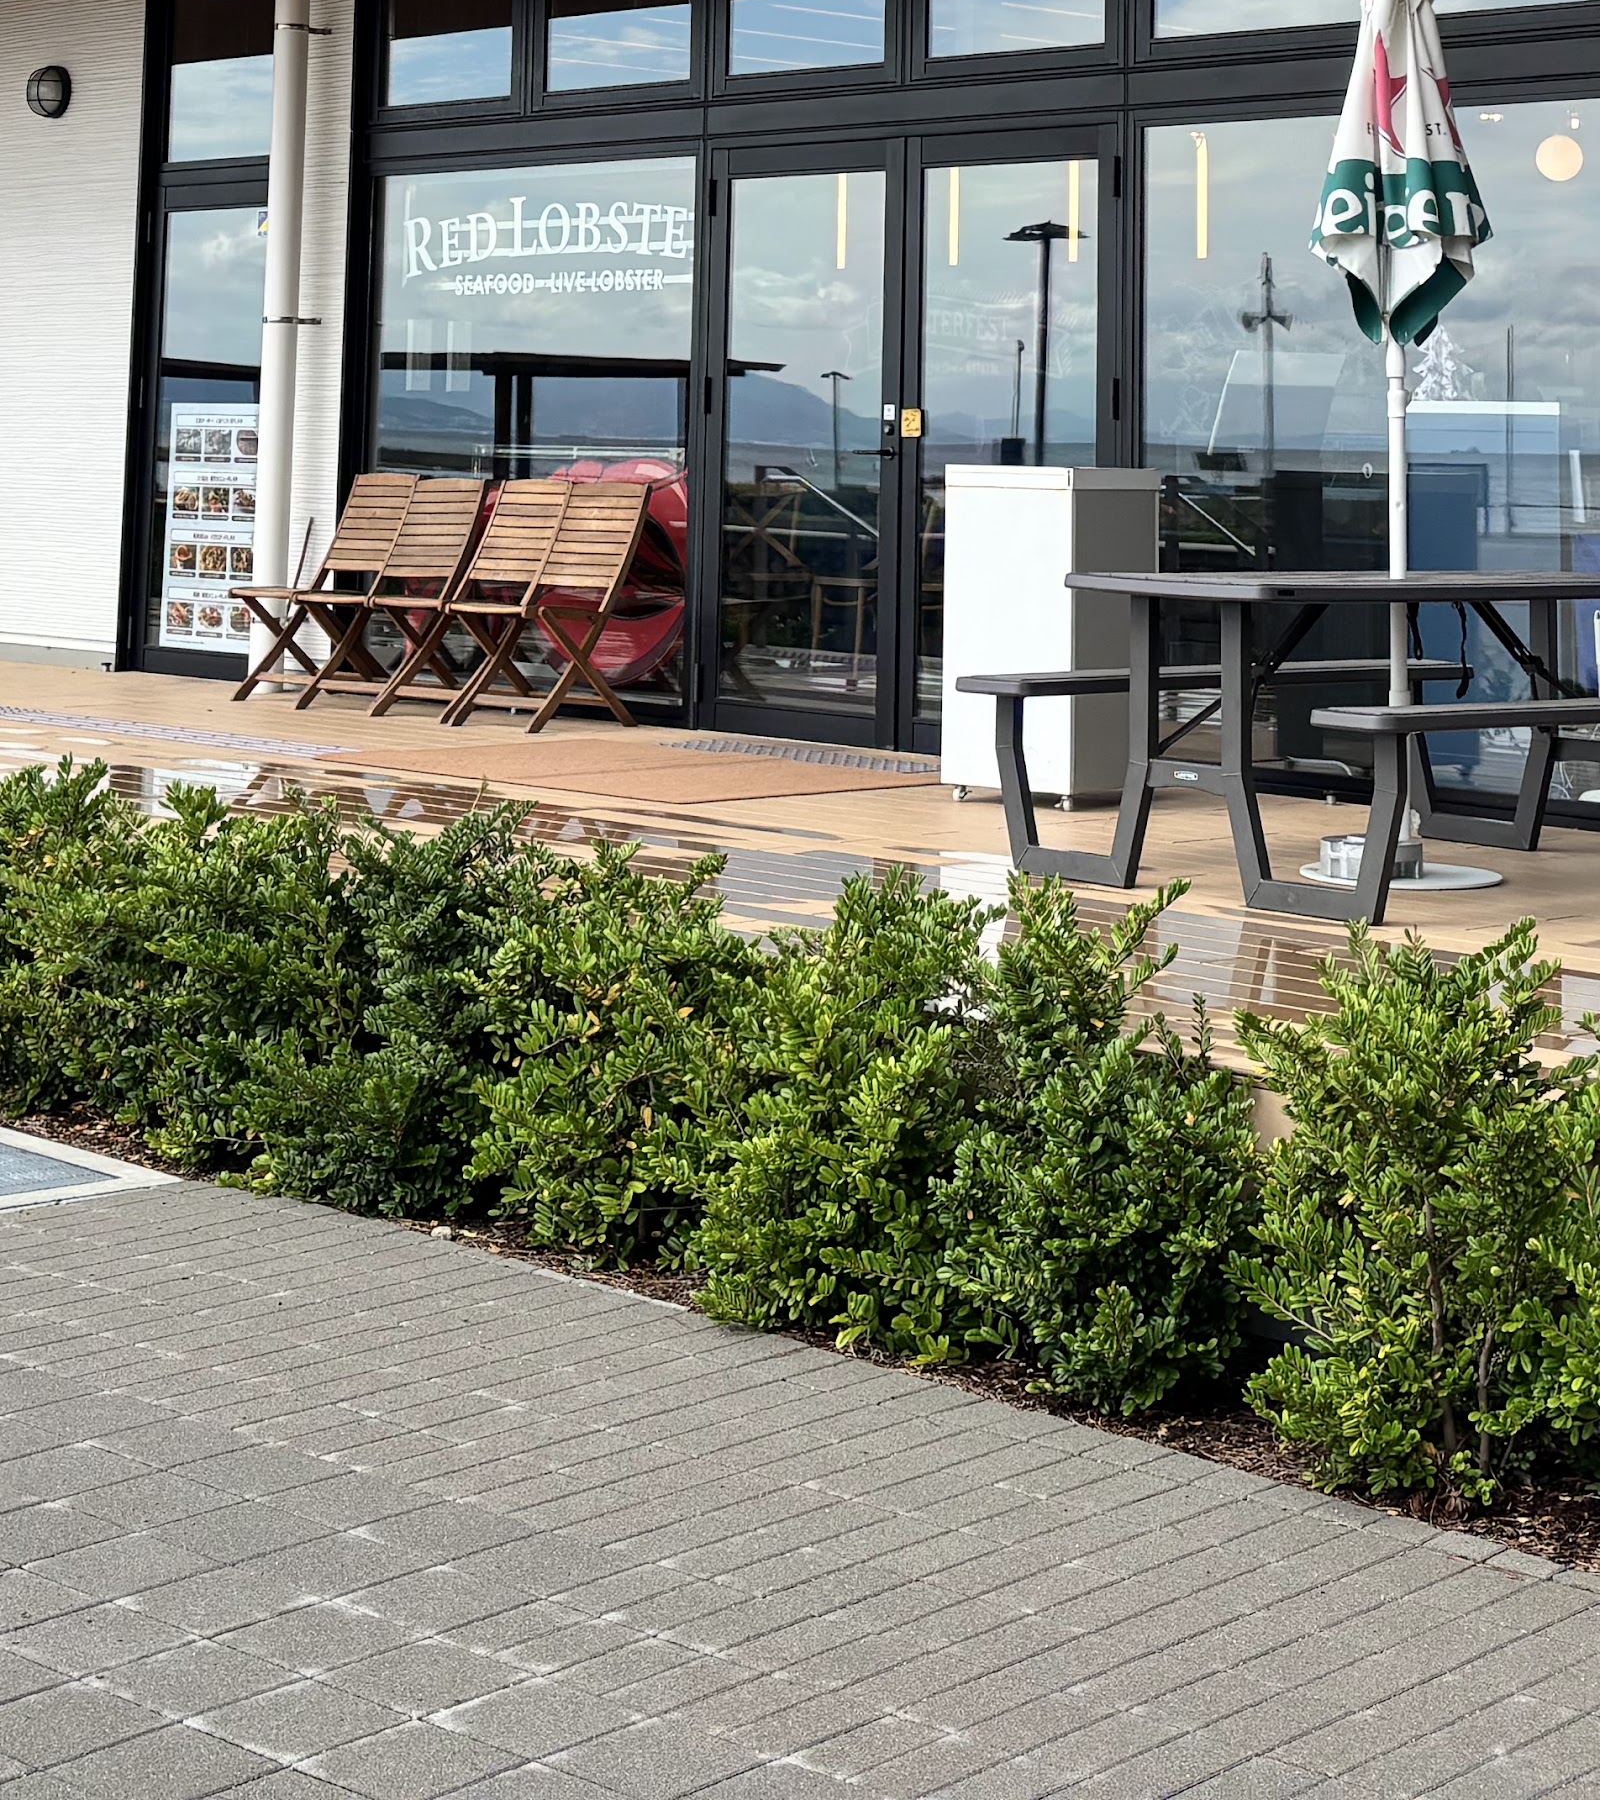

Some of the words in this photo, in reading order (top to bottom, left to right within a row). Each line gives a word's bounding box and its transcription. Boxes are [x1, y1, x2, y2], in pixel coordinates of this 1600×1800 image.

[403, 212, 497, 278] RED
[509, 196, 694, 261] LOBSTE
[455, 273, 535, 295] SEAFOOD
[550, 271, 587, 293] LIVE
[591, 269, 664, 292] LOBSTER
